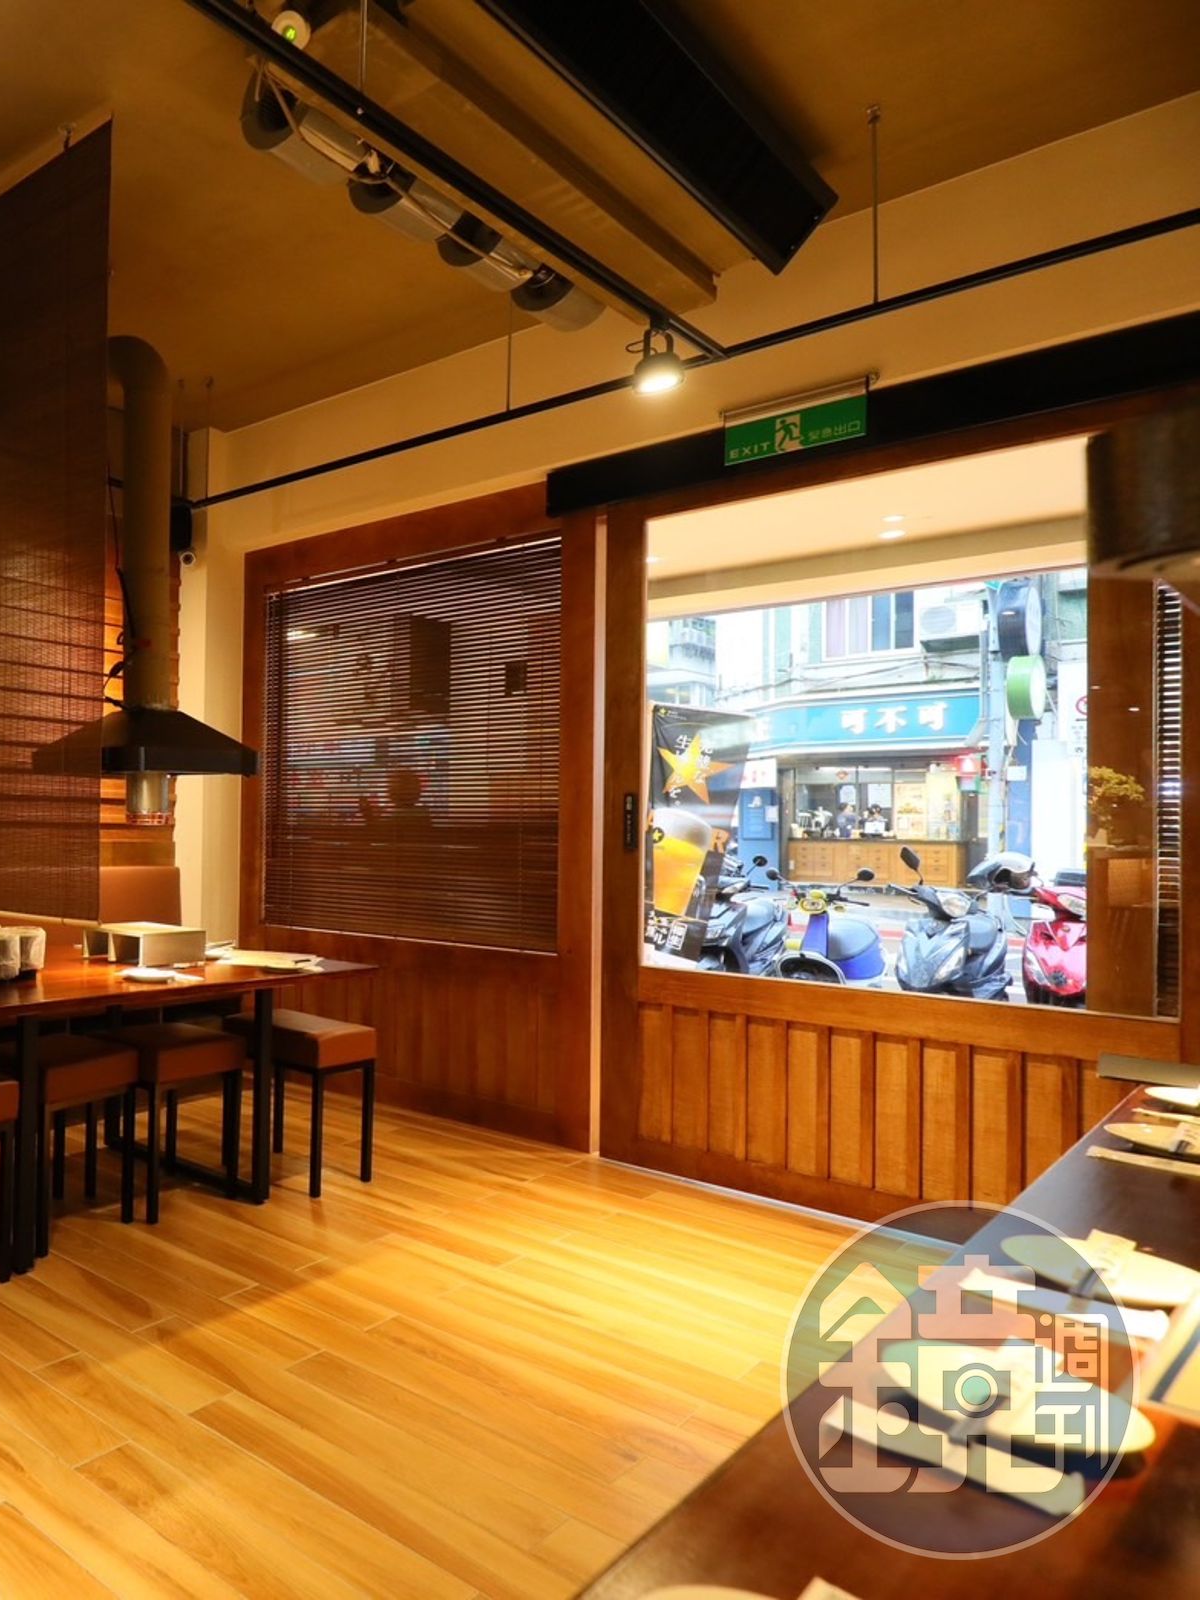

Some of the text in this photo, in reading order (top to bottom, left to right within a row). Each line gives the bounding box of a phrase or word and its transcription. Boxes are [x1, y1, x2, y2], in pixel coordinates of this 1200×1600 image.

[808, 420, 861, 441] 緊急出口
[728, 442, 771, 459] EXIT
[839, 701, 948, 736] 可不可
